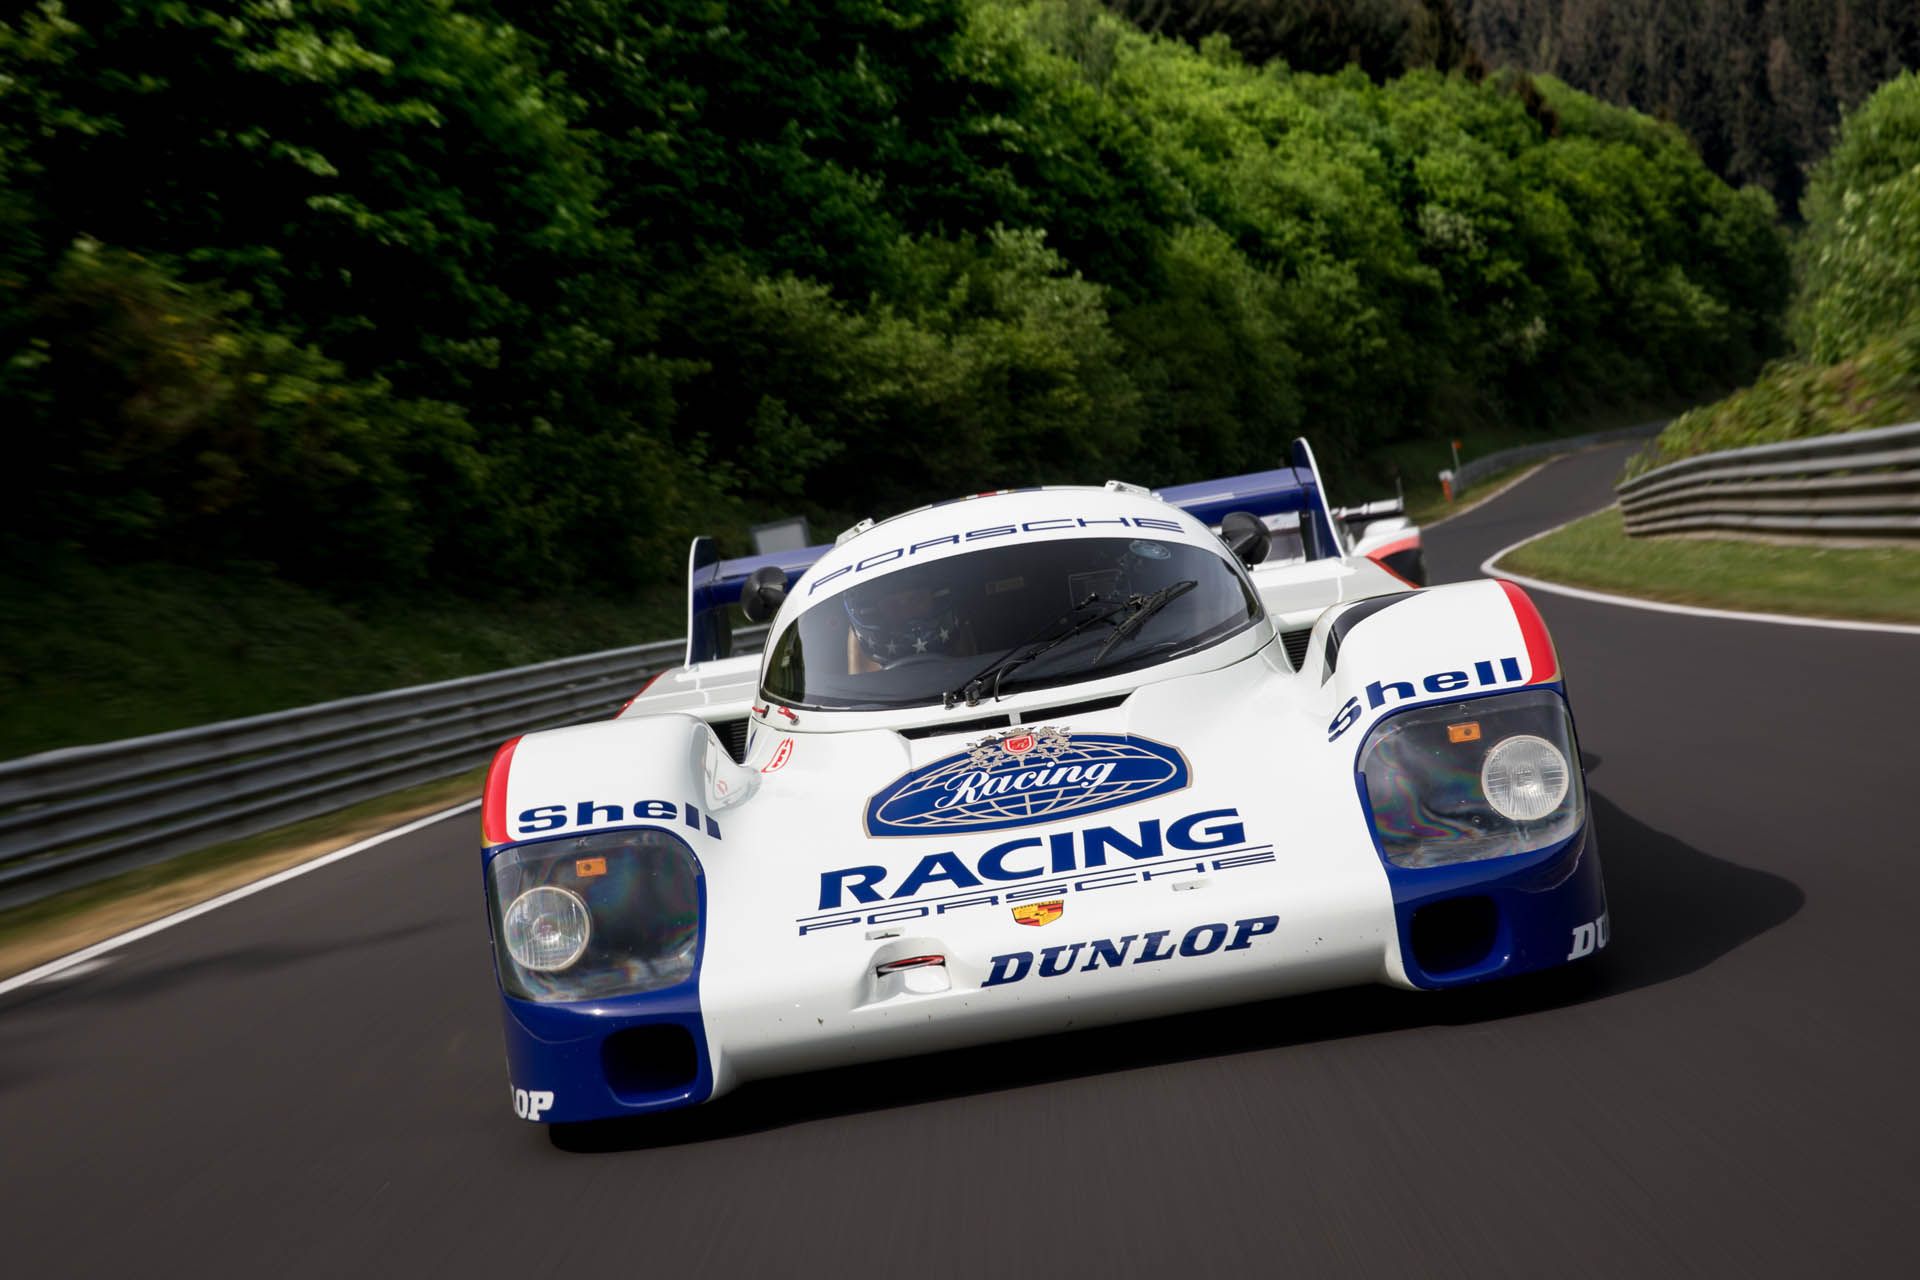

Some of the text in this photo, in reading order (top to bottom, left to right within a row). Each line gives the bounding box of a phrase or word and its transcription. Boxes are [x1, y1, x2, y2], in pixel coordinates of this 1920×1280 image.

[808, 517, 1185, 595] PORSCHE
[1328, 657, 1522, 743] Shell
[518, 800, 722, 840] Shell
[934, 761, 1117, 808] Racing
[798, 851, 1277, 936] PORSCHE
[818, 808, 1246, 910] RACING
[981, 915, 1280, 988] DUNLOP
[511, 1085, 554, 1121] OP
